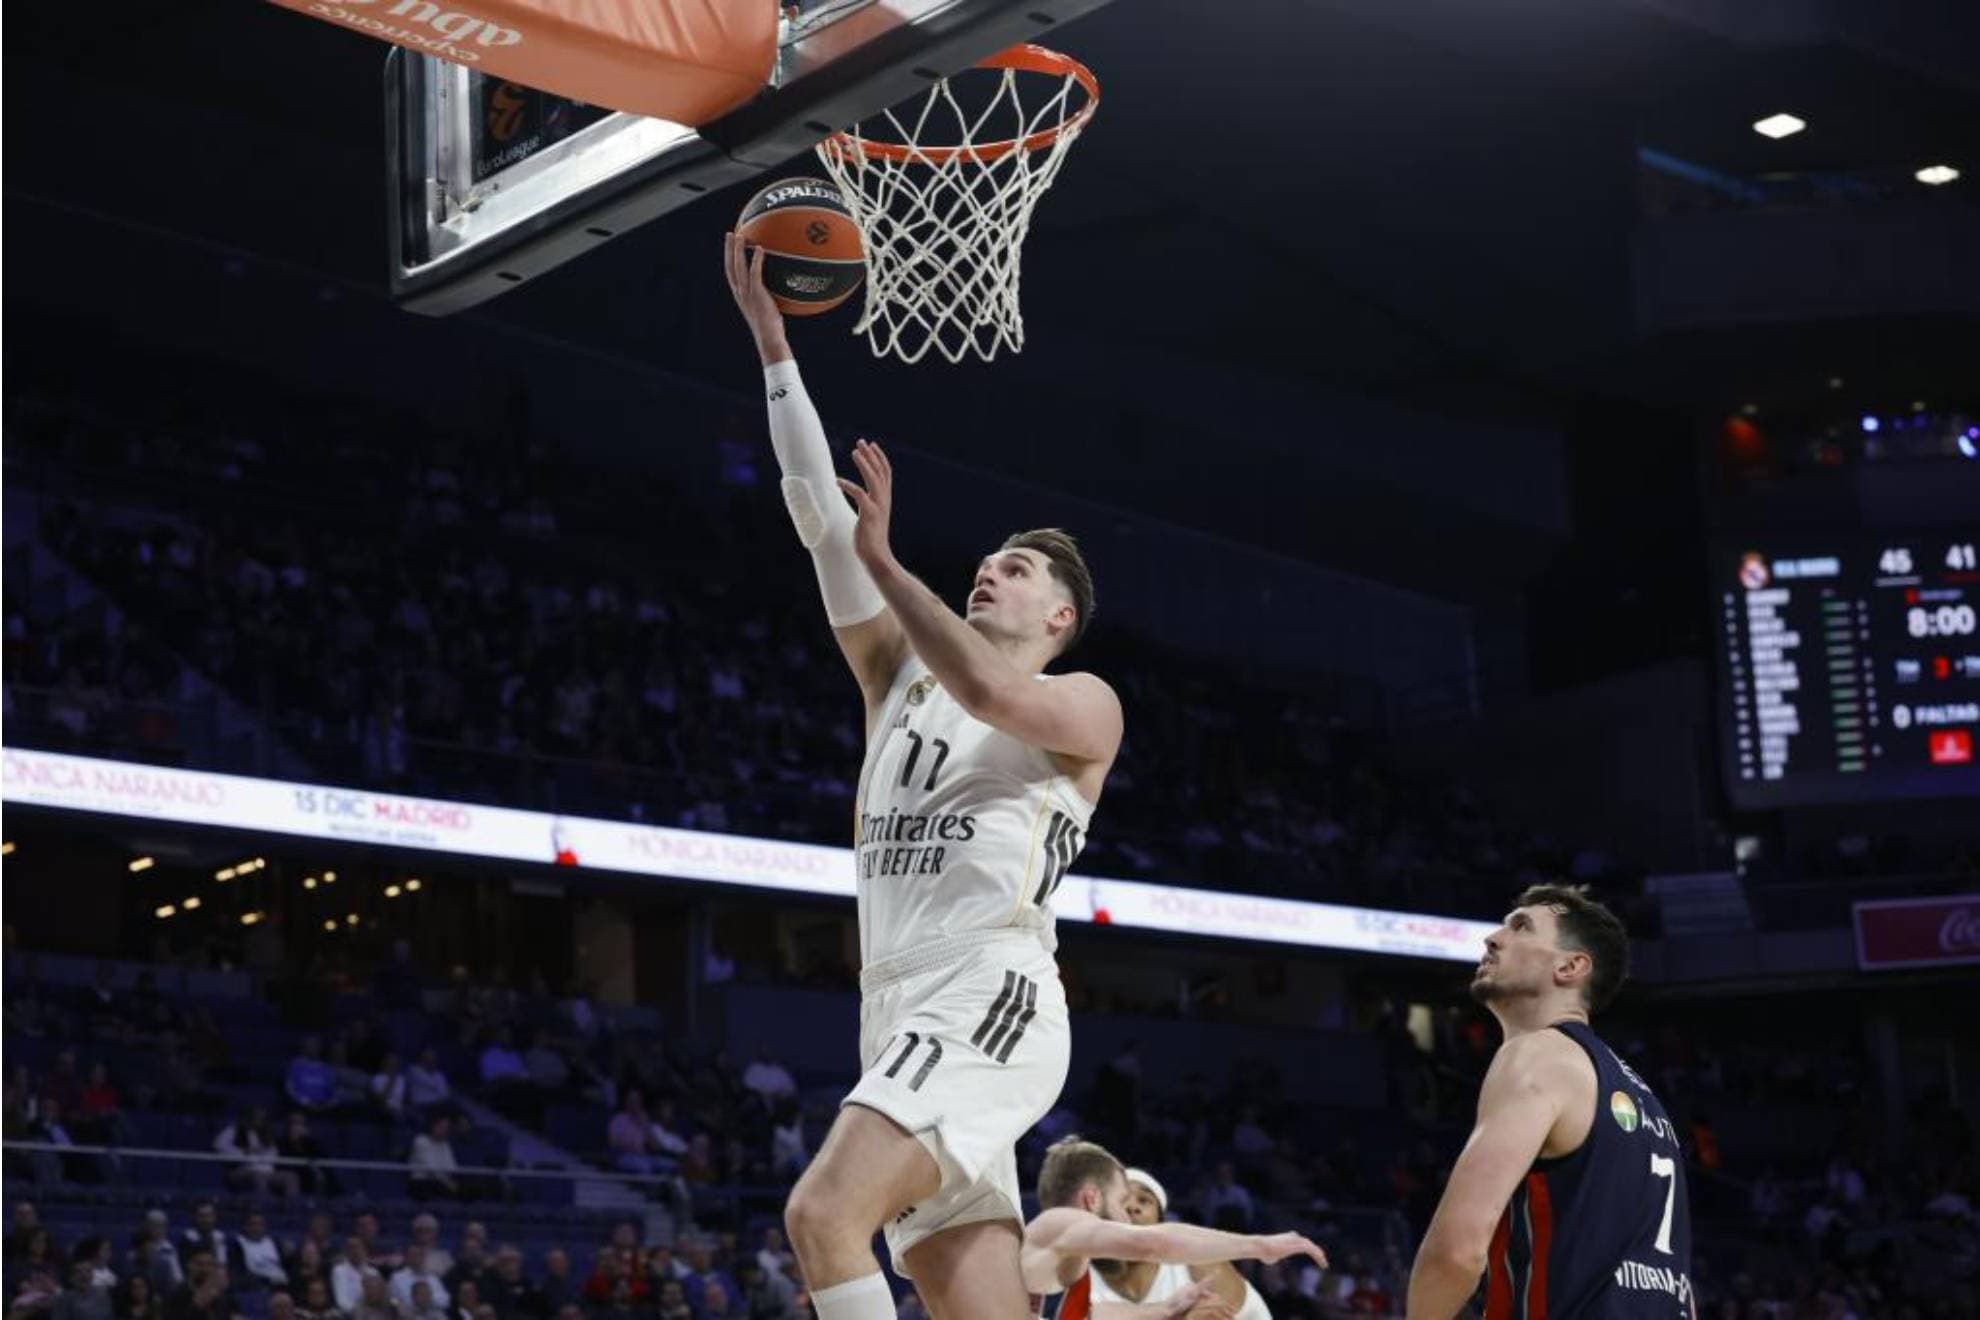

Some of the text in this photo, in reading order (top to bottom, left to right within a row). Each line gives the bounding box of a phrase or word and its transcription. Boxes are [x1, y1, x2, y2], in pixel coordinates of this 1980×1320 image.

[1908, 605, 1976, 637] 8:00
[881, 846, 945, 877] BETTER
[1651, 1153, 1676, 1255] 7
